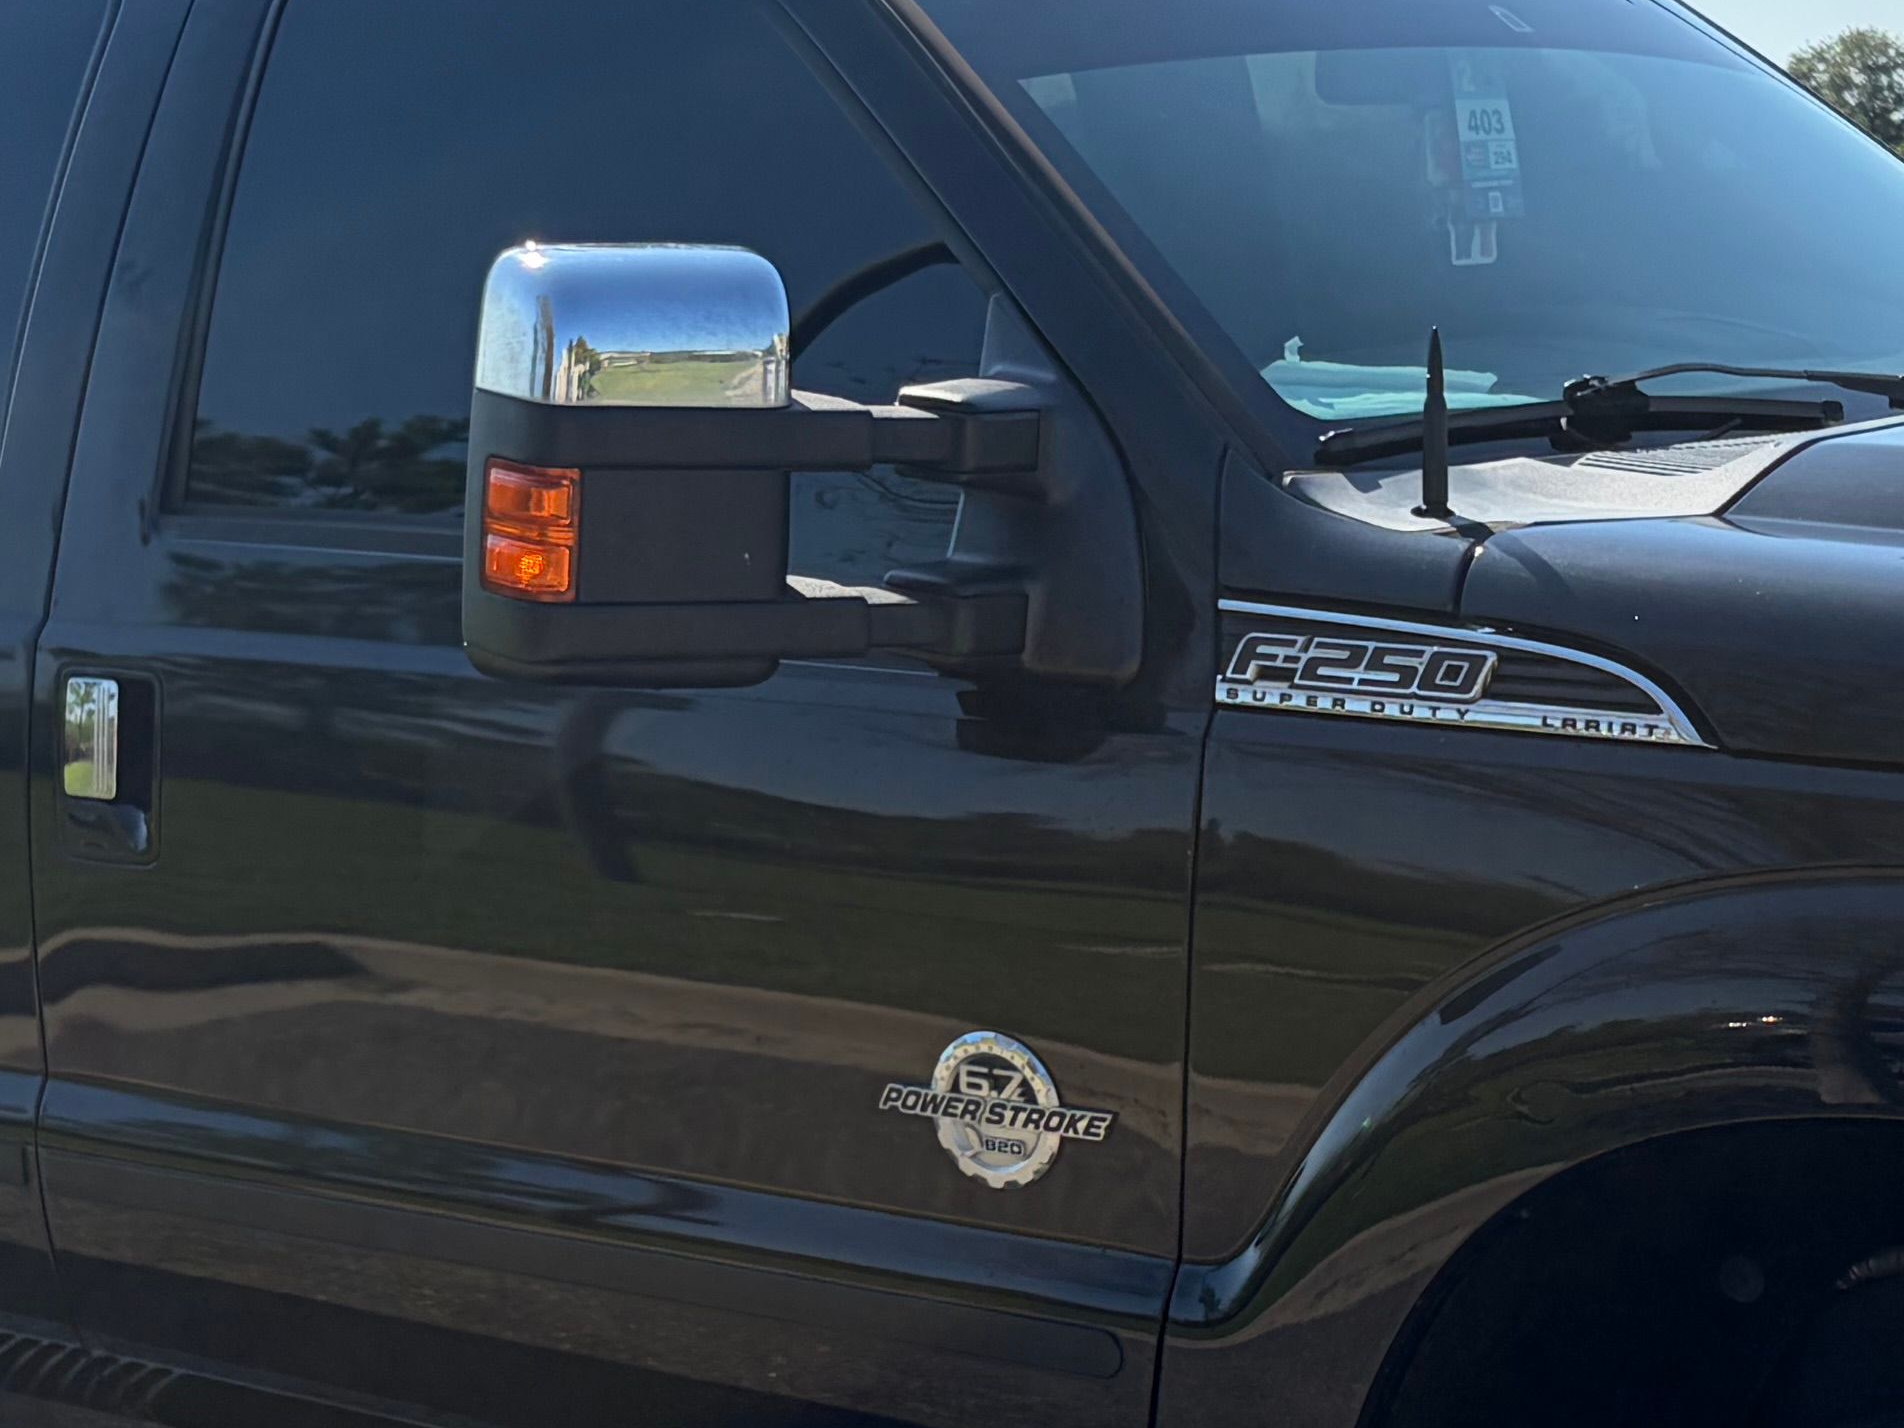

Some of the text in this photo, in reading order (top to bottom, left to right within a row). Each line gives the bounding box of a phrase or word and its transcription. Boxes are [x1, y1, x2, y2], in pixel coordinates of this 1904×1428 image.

[1467, 108, 1505, 136] 403
[1225, 632, 1498, 701] F-250
[1225, 687, 1471, 721] SUPER DUTY
[1541, 715, 1660, 738] LARIAT
[880, 1084, 1114, 1141] POWER STROKE
[984, 1138, 1024, 1156] B20
